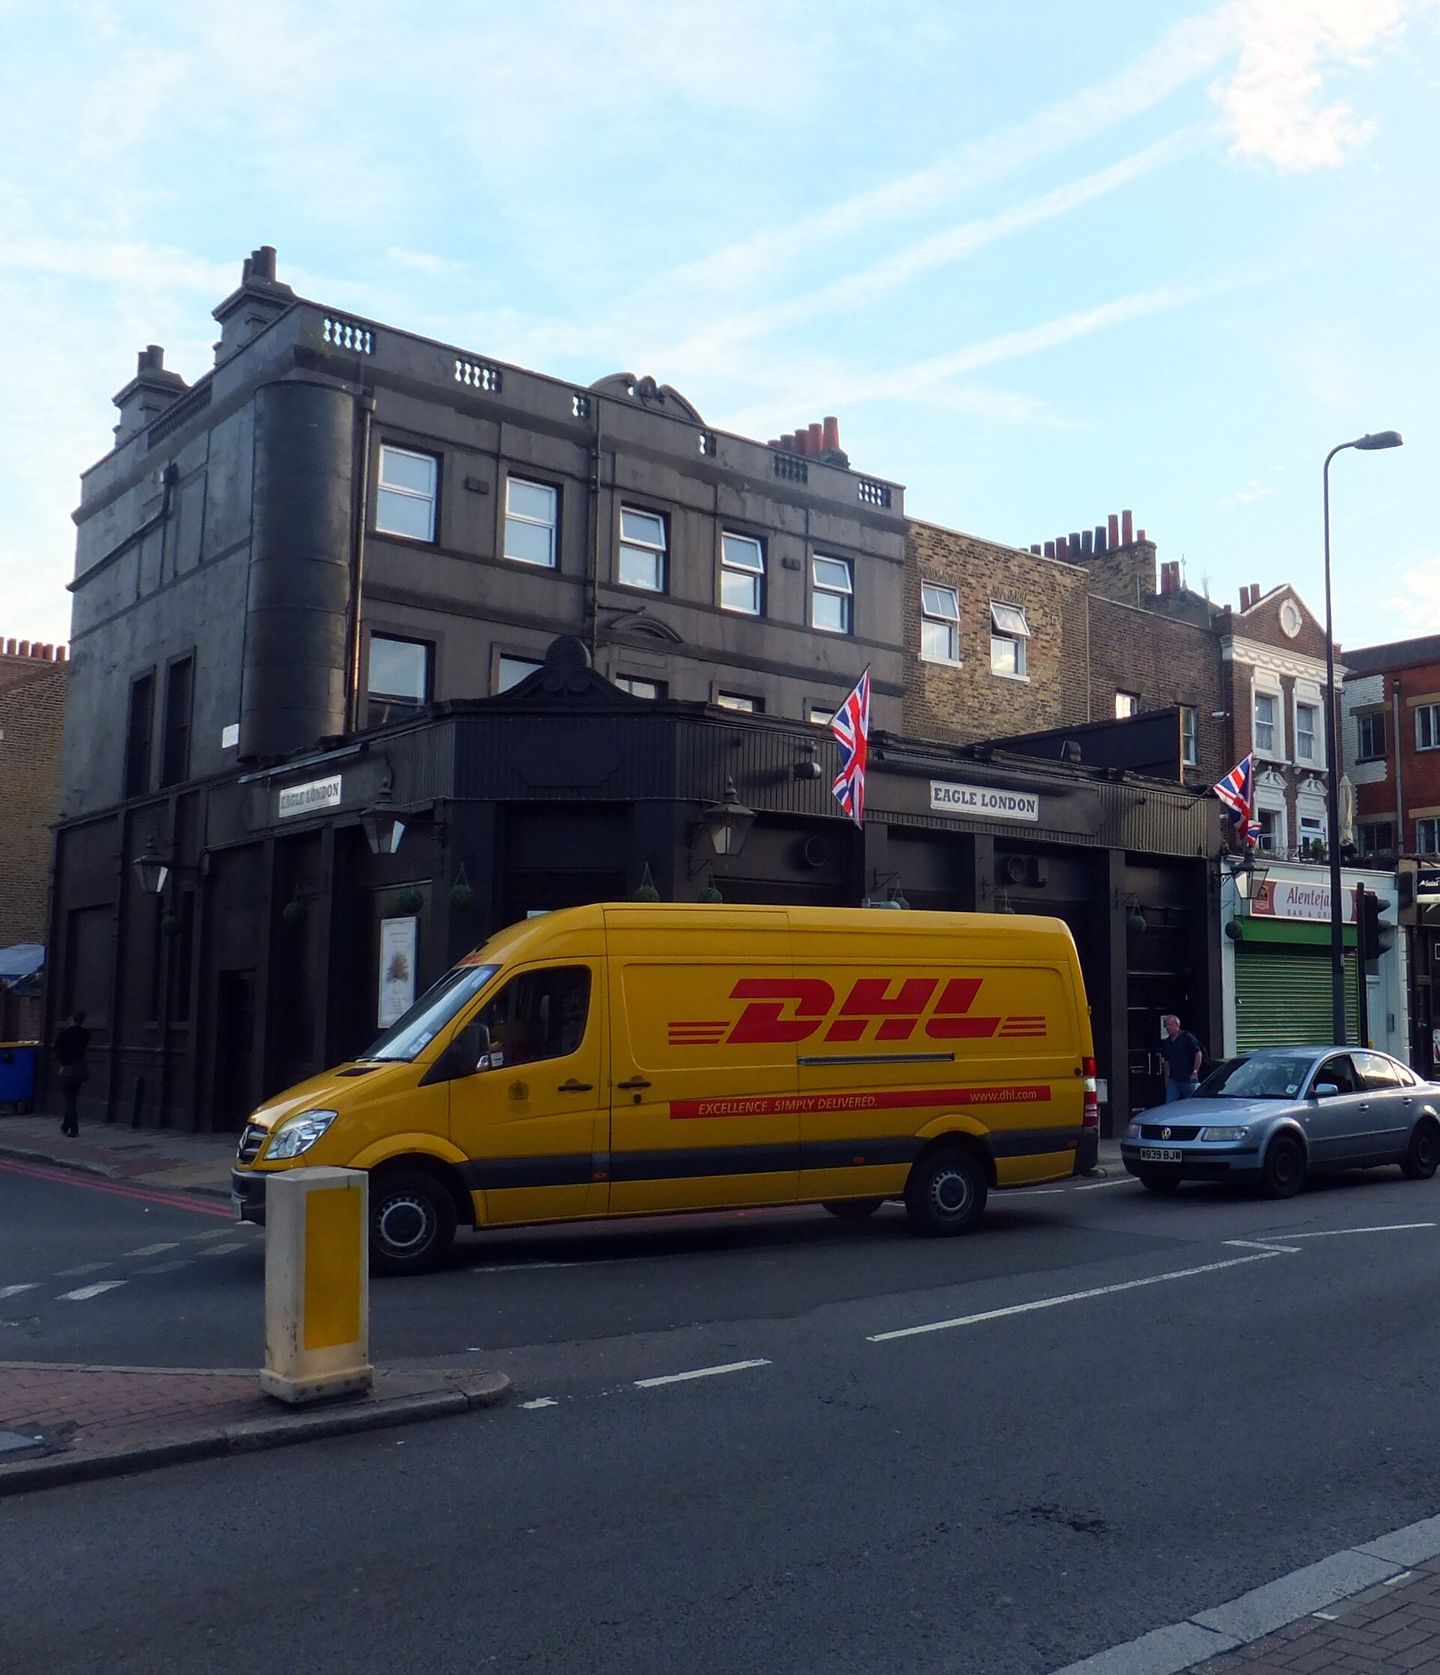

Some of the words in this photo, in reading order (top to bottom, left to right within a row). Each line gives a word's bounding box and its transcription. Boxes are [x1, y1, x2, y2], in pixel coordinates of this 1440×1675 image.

[306, 782, 339, 803] LONDON
[934, 788, 976, 805] EAGLE
[981, 793, 1035, 813] LONDON
[1286, 887, 1330, 910] Alenteja
[725, 978, 1001, 1044] DHL
[774, 1099, 815, 1112] SIMPLY
[969, 1089, 1037, 1102] www.dhl.com
